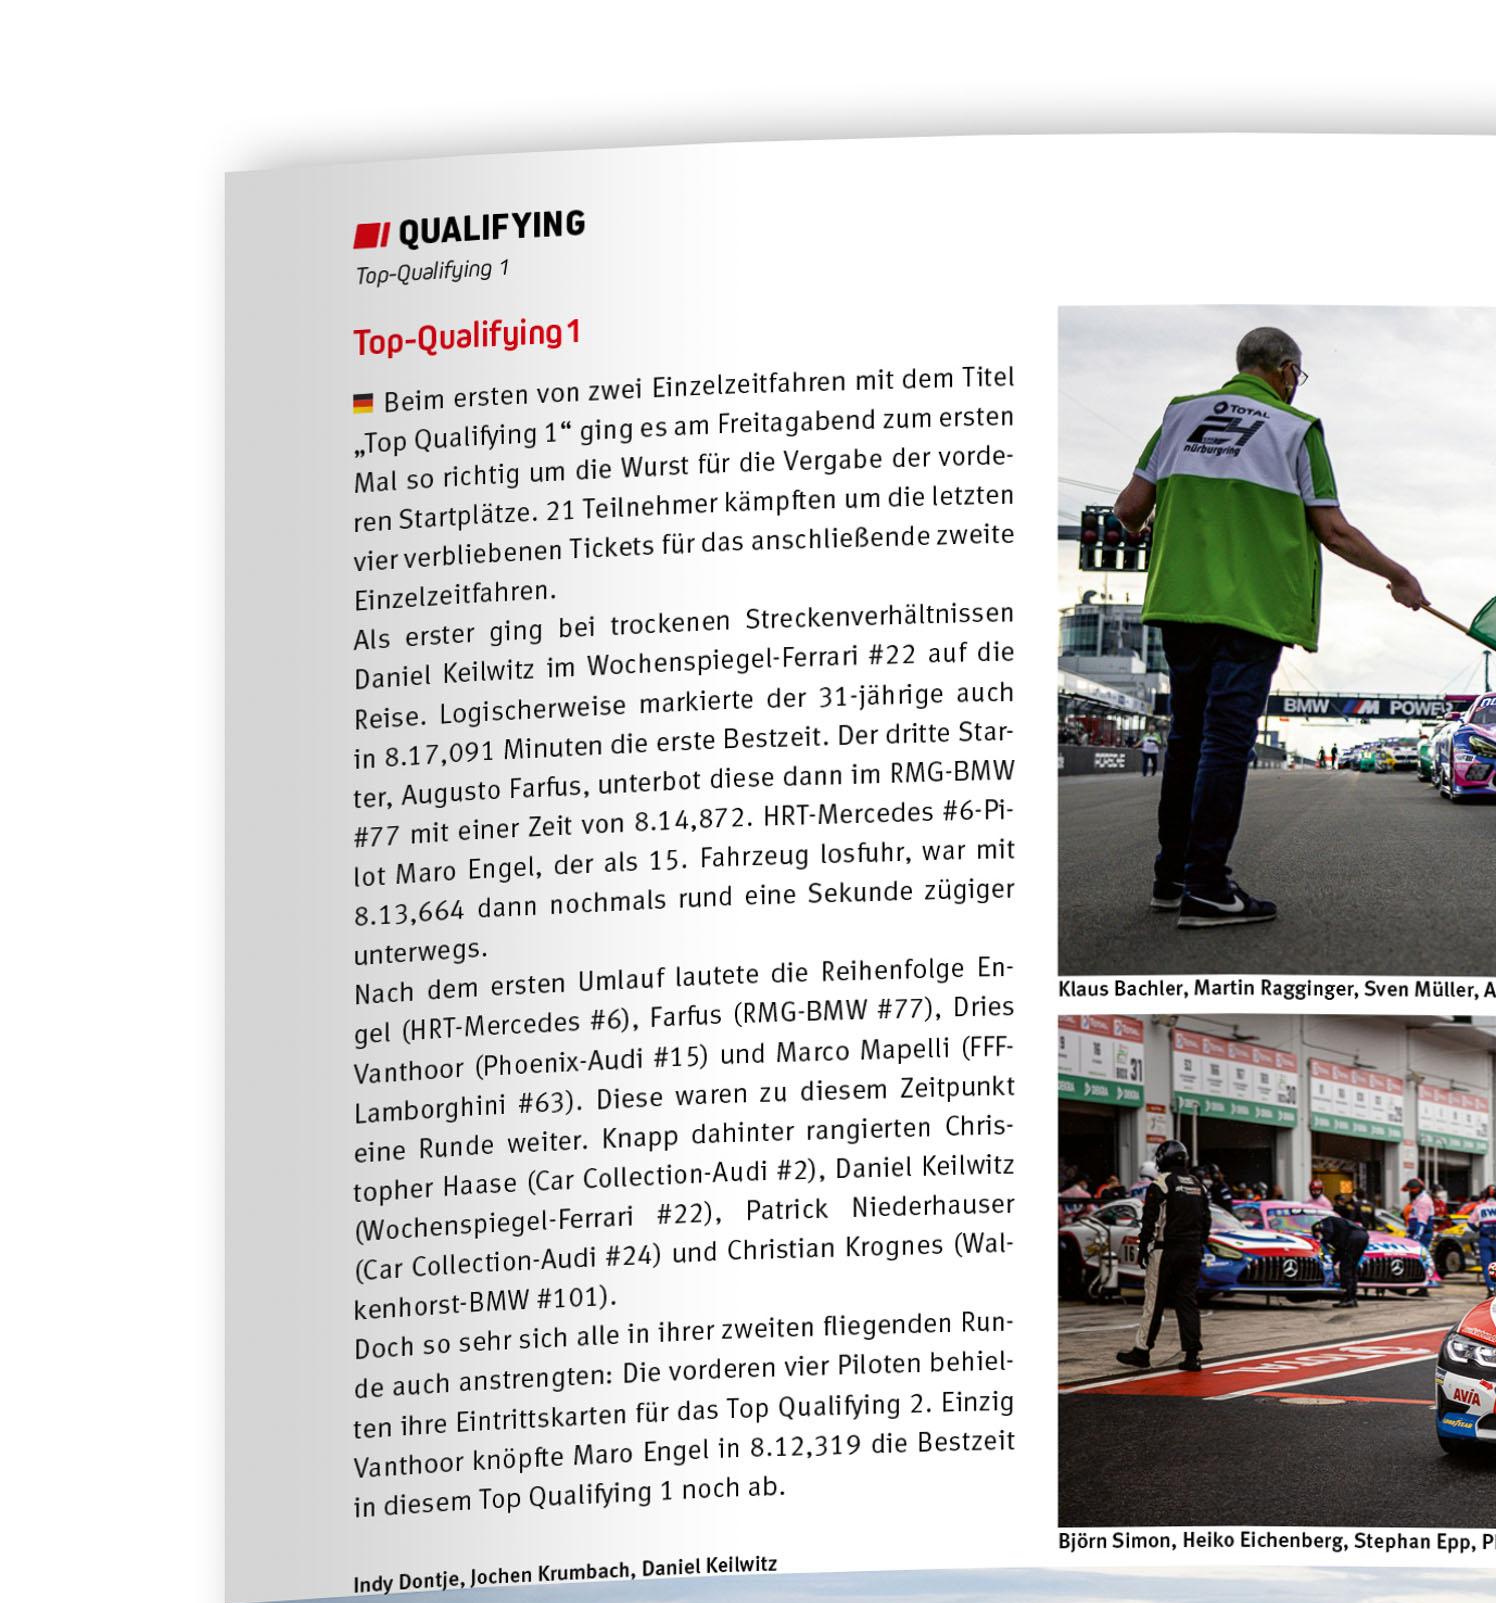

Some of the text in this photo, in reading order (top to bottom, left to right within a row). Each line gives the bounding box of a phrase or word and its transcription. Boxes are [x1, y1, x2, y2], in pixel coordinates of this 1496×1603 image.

[399, 209, 585, 251] QUALIFYING
[356, 258, 509, 288] Top-Qualifying 1
[353, 318, 579, 359] Top-Qualifying 1
[384, 365, 1015, 414] Beim ersten von zwei Einzelzeitfahren mit dem Titel
[1230, 404, 1271, 419] TOTAL
[1183, 444, 1241, 457] nürburgring
[1283, 698, 1329, 714] BMW
[1059, 980, 1109, 997] Klaus
[1115, 979, 1189, 999] Bachler,
[1194, 979, 1255, 996] Martin
[1261, 979, 1359, 1001] Ragginger,
[1364, 980, 1409, 997] Sven
[1415, 980, 1479, 1000] Müller,
[1130, 1058, 1143, 1082] 31
[353, 1429, 1016, 1479] Vanthoor knöpfte Maro Engel in 8.12,319 die Bestzeit
[1059, 1532, 1107, 1553] Björn
[1112, 1532, 1177, 1551] Simon,
[1183, 1531, 1235, 1548] Heiko
[1240, 1531, 1348, 1553] Eichenberg,
[1354, 1532, 1430, 1553] Stephan
[1437, 1532, 1476, 1554] Epp,
[354, 1555, 777, 1596] Indy Dontje, Jochen Krumbach, Daniel Keilwitz
